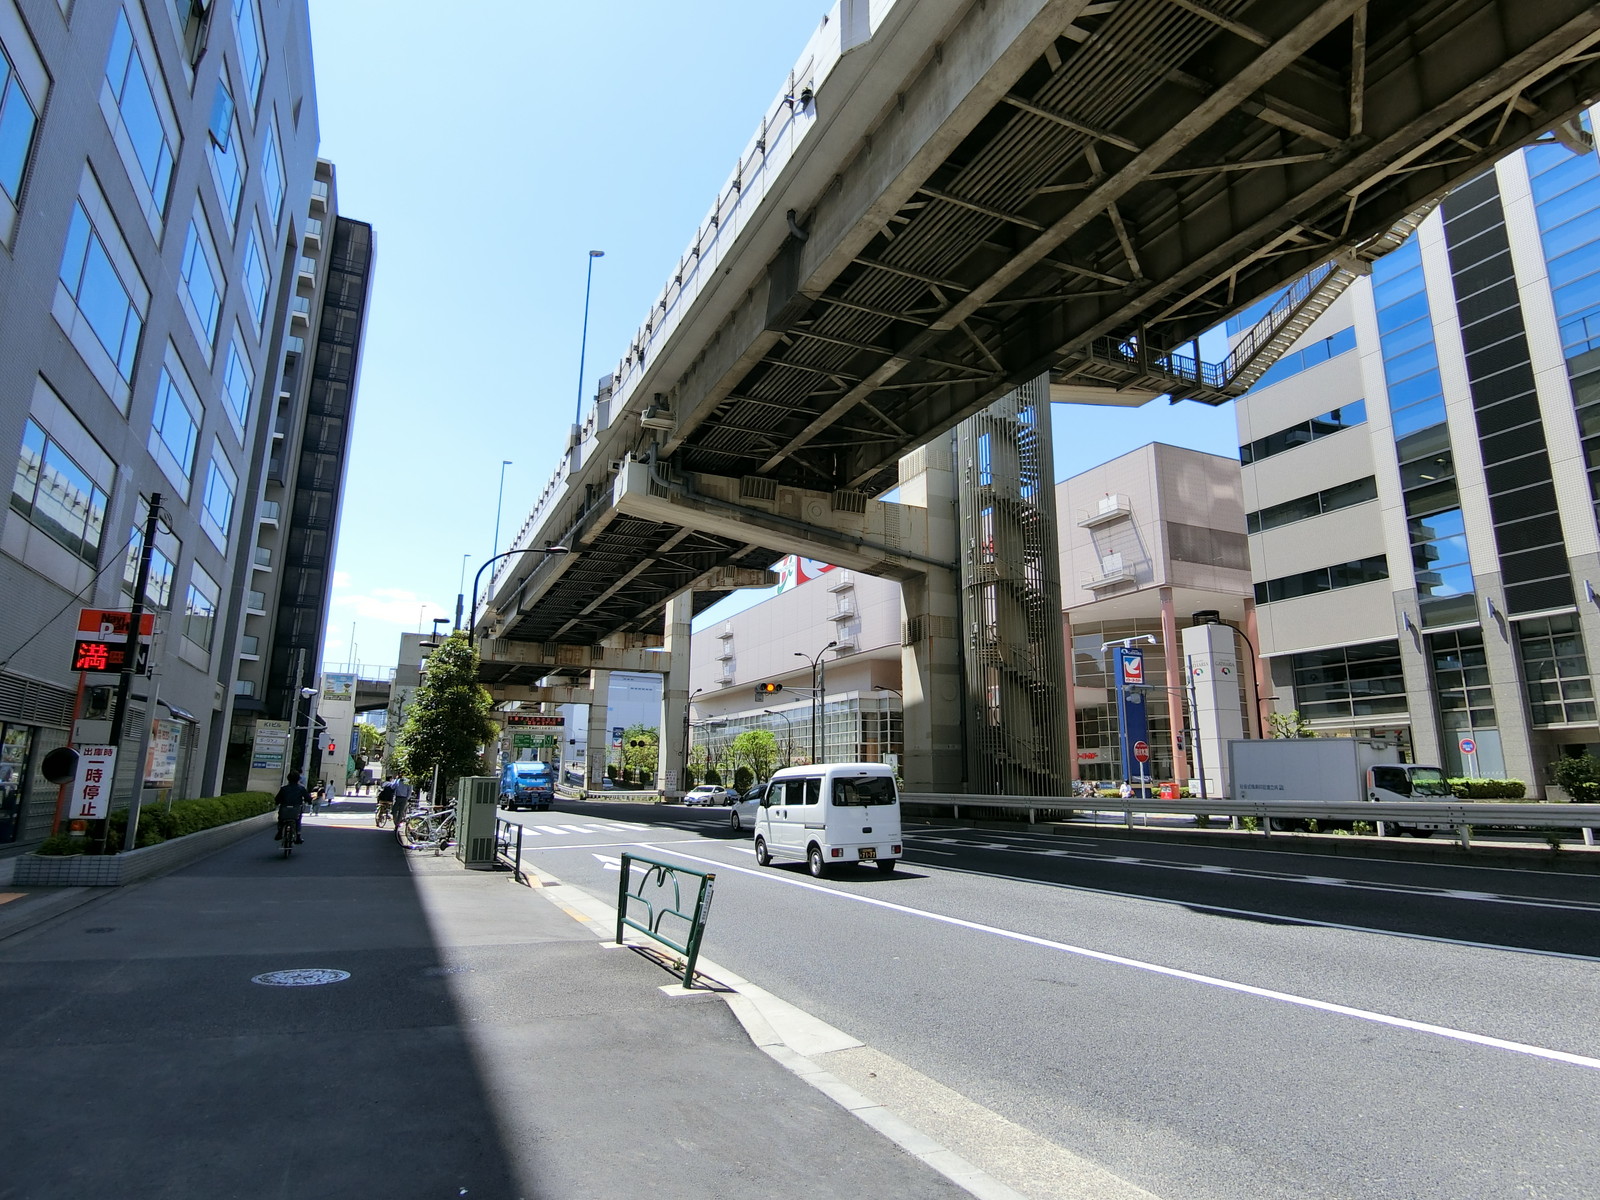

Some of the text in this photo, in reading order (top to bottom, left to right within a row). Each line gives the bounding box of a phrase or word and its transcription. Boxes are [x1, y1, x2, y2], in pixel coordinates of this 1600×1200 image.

[76, 643, 108, 670] 満
[83, 748, 113, 756] 出庫時
[80, 760, 105, 817] 一時停止
